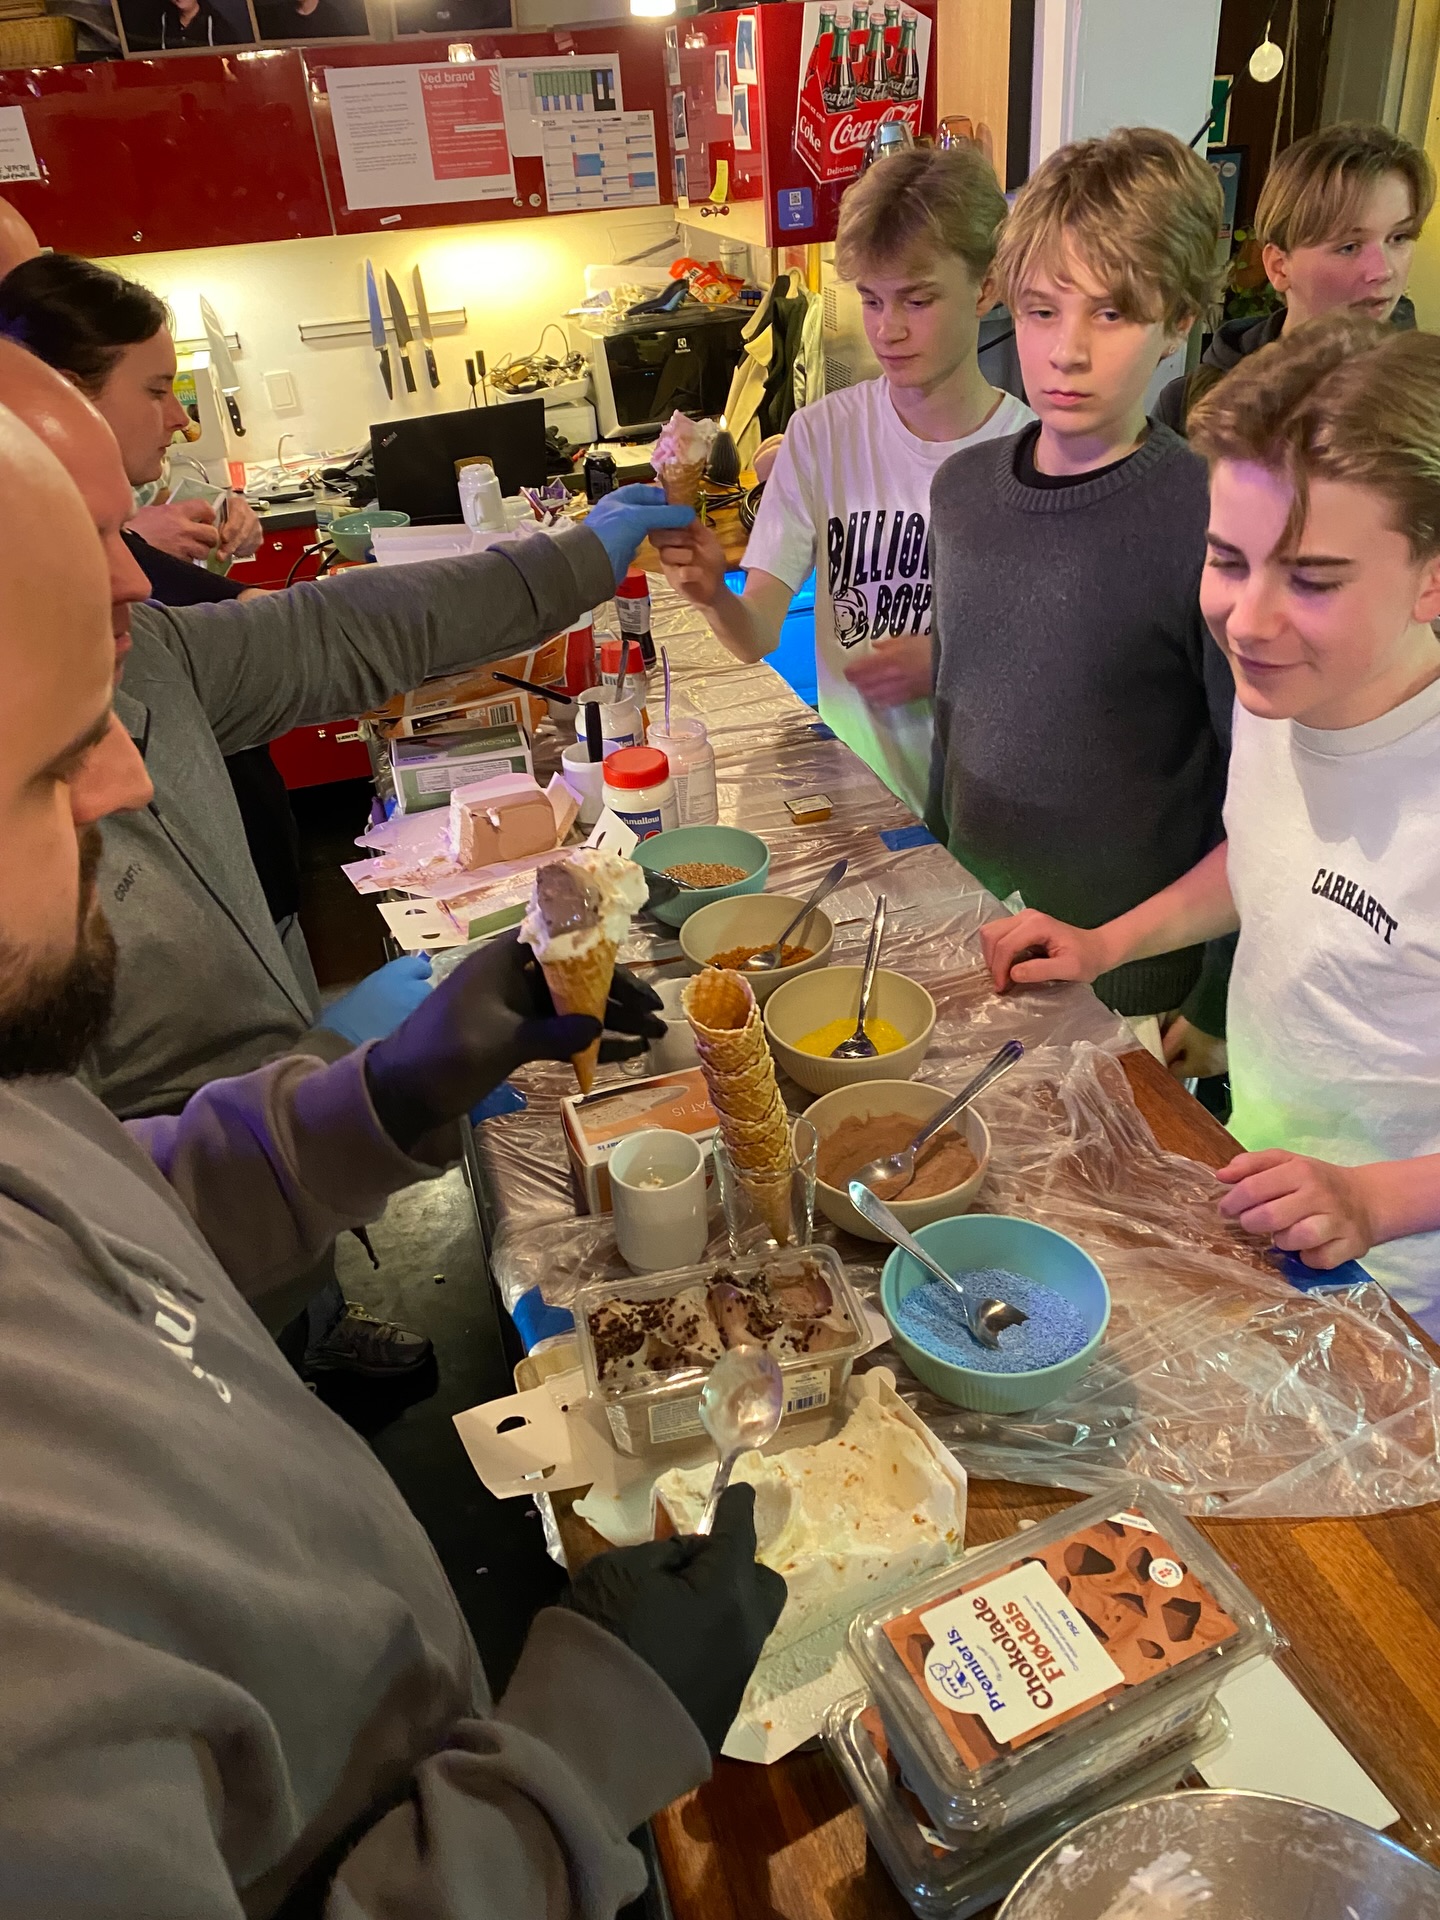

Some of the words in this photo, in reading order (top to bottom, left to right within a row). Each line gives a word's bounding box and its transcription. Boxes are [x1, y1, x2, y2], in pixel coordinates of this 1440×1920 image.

[421, 73, 441, 84] Ved
[444, 70, 475, 82] brand
[800, 115, 821, 153] Coke
[620, 815, 660, 826] hmallow
[114, 863, 141, 902] CRAFT
[1311, 868, 1399, 945] CARHARTT
[671, 1107, 686, 1117] IS
[1002, 1601, 1066, 1684] Flødeis
[1066, 1620, 1080, 1637] 750
[972, 1596, 1053, 1710] Chokolade
[956, 1645, 1006, 1712] Premier
